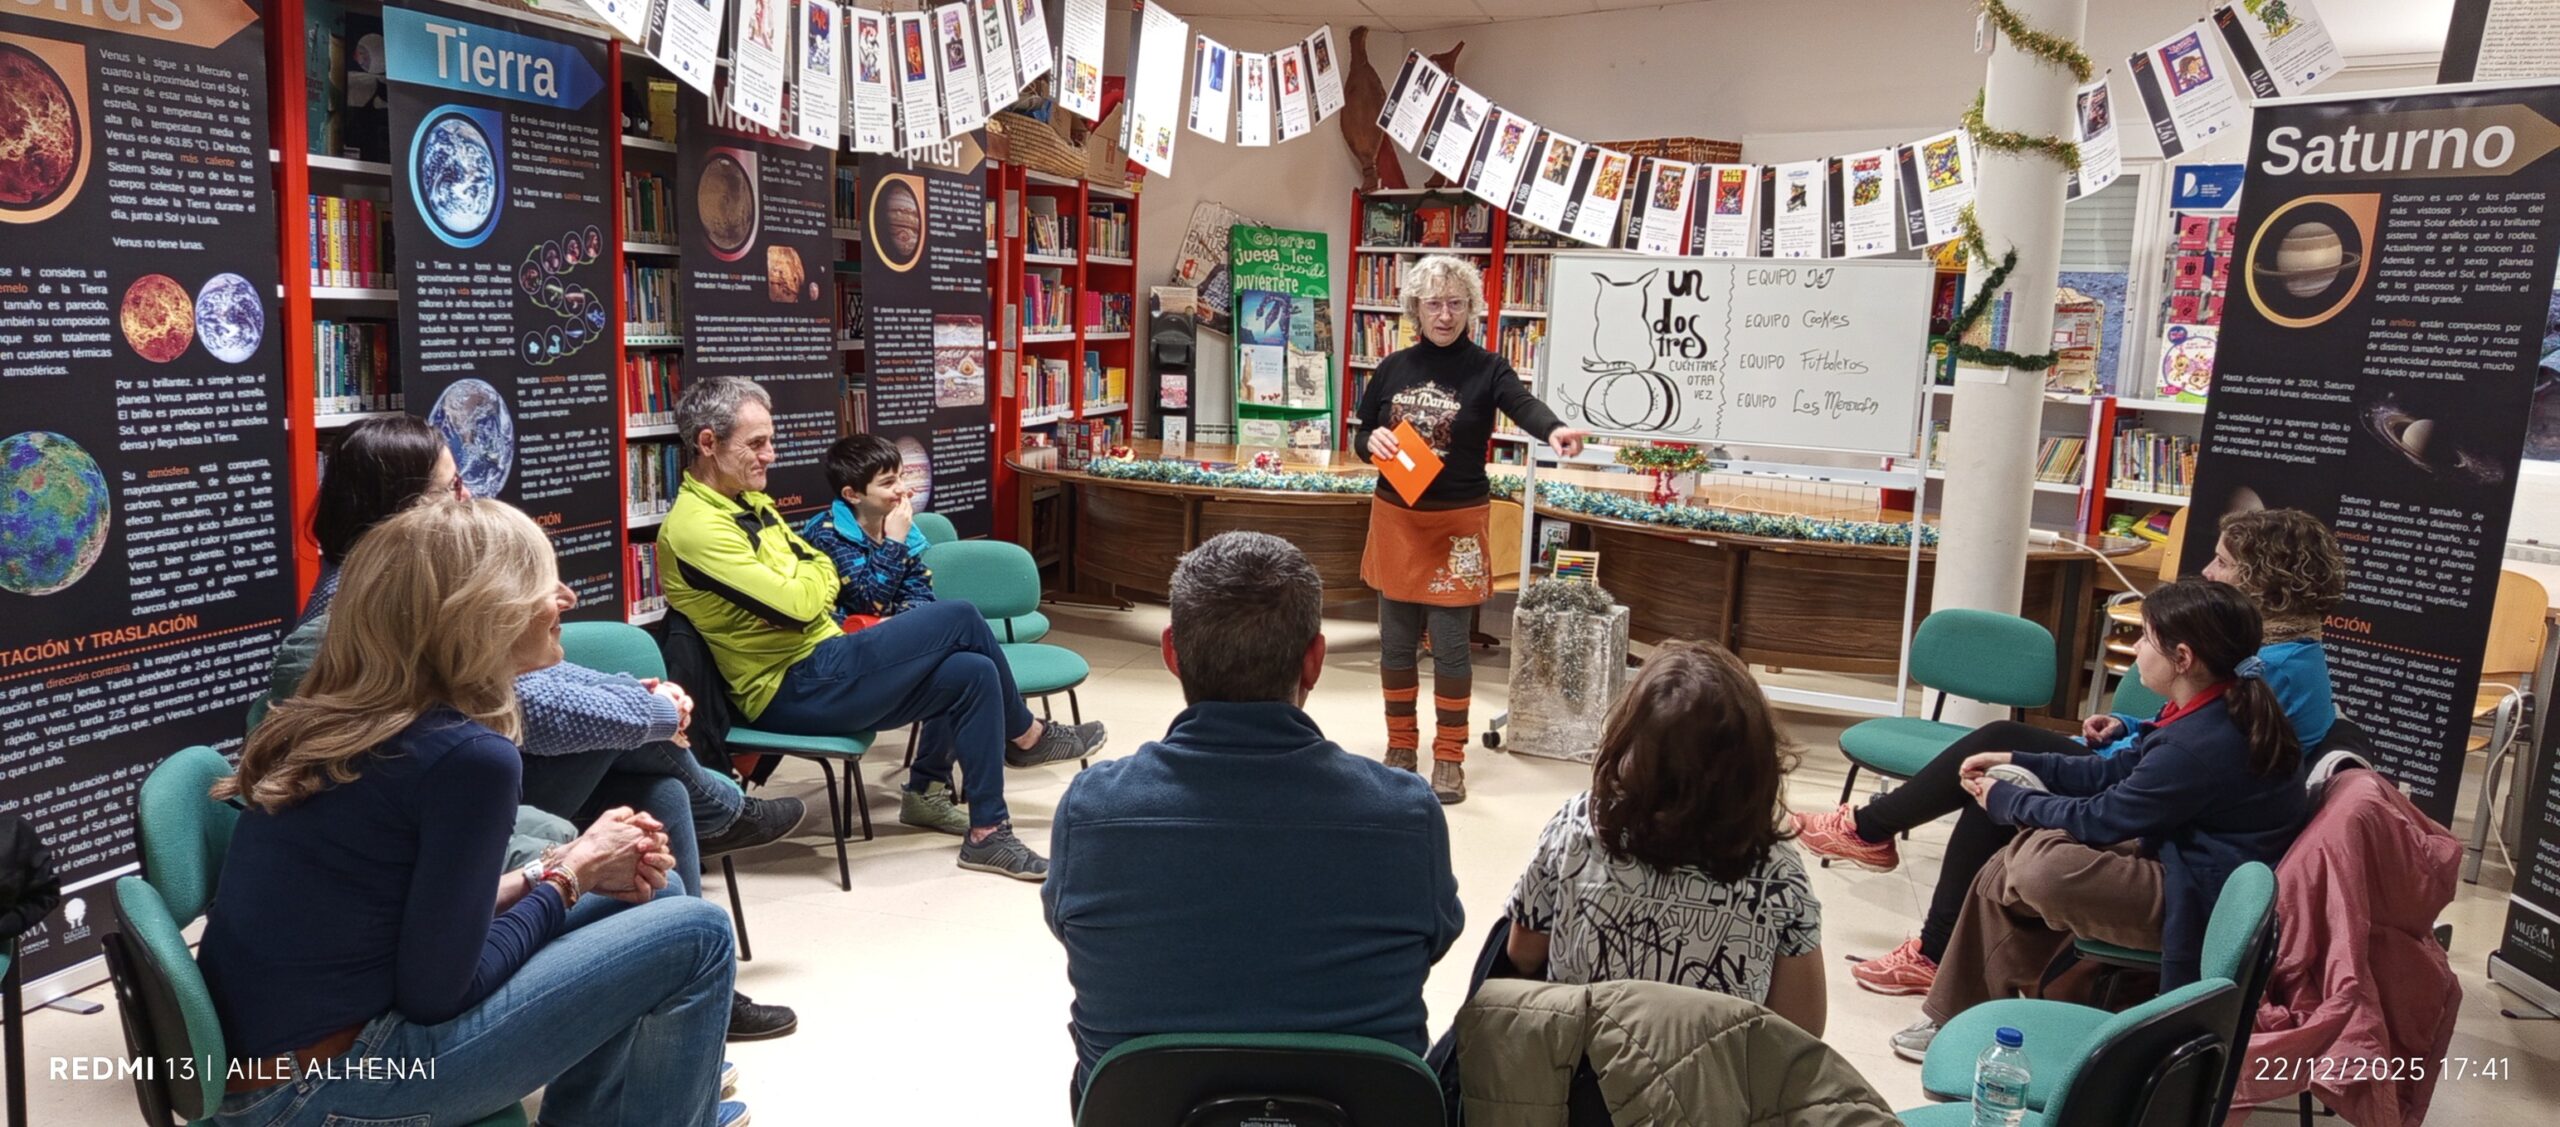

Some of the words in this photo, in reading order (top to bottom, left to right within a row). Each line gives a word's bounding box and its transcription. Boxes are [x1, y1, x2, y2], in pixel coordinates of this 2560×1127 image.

[100, 48, 130, 62] Venus
[137, 53, 146, 65] le
[152, 58, 177, 70] sigue
[183, 63, 190, 72] a
[196, 63, 232, 78] Mercurio
[236, 72, 248, 81] en
[425, 23, 558, 99] Tierra
[2250, 68, 2275, 98] 1970
[2155, 117, 2178, 145] 1971
[2261, 125, 2516, 176] Saturno
[107, 160, 146, 174] Sistema
[149, 164, 172, 176] Solar
[176, 169, 183, 179] y
[187, 170, 204, 179] uno
[207, 170, 219, 181] de
[222, 171, 235, 182] los
[238, 174, 254, 184] tres
[2391, 193, 2425, 202] Saturno
[2429, 194, 2440, 202] es
[2445, 193, 2464, 202] uno
[2467, 192, 2480, 201] de
[2485, 192, 2499, 201] los
[2504, 192, 2546, 201] planetas
[1563, 201, 1580, 224] 1979
[1909, 208, 1925, 234] 1974
[2389, 206, 2407, 215] más
[2416, 206, 2451, 215] vistosos
[2460, 206, 2467, 216] y
[2476, 205, 2517, 214] coloridos
[2527, 204, 2544, 213] del
[1628, 216, 1643, 239] 1978
[1831, 220, 1845, 245] 1975
[2387, 218, 2421, 227] Sistema
[2423, 218, 2446, 227] Solar
[2447, 218, 2478, 227] debido
[2479, 219, 2487, 227] a
[2489, 219, 2501, 227] su
[2503, 217, 2541, 227] brillante
[112, 236, 143, 248] Venus
[143, 239, 156, 248] no
[156, 239, 178, 249] tiene
[178, 239, 204, 250] lunas.
[1253, 231, 1316, 250] colorea
[1692, 226, 1706, 249] 1977
[1761, 227, 1774, 251] 1976
[2385, 232, 2418, 240] sistema
[2425, 231, 2438, 240] de
[2440, 230, 2469, 240] anillos
[2472, 232, 2491, 241] que
[2494, 230, 2504, 240] lo
[2507, 232, 2537, 240] rodea.
[1235, 248, 1280, 266] juega
[1292, 248, 1313, 264] lee
[0, 267, 12, 276] se
[20, 266, 31, 277] le
[38, 268, 87, 278] considera
[93, 269, 107, 278] un
[1272, 262, 1327, 278] aprende
[1746, 268, 1797, 287] EQUIPO
[37, 282, 52, 294] de
[60, 283, 71, 294] la
[80, 283, 108, 294] Tierra
[1666, 269, 1710, 302] un
[3, 299, 43, 310] tamaño
[47, 300, 60, 310] es
[64, 300, 108, 310] parecido,
[36, 317, 49, 326] su
[50, 316, 110, 326] composición
[1653, 298, 1706, 342] dos
[1745, 313, 1790, 329] EQUIPO
[1802, 309, 1850, 329] Cookies
[2370, 317, 2386, 326] Los
[2419, 320, 2444, 328] están
[2447, 321, 2501, 331] compuestos
[2504, 324, 2522, 333] por
[32, 333, 52, 343] son
[61, 332, 111, 342] totalmente
[1656, 334, 1708, 360] tres
[0, 351, 14, 360] en
[16, 349, 70, 360] cuestiones
[71, 348, 112, 358] térmicas
[1739, 353, 1785, 371] EQUIPO
[1800, 348, 1869, 375] Futboleros
[2, 364, 68, 377] atmosféricas.
[1687, 374, 1715, 386] OTRA
[1694, 390, 1713, 400] VEZ
[1736, 392, 1777, 409] EQUIPO
[1792, 389, 1820, 416] Los
[2340, 494, 2371, 506] Saturno
[2379, 500, 2400, 510] tiene
[2408, 504, 2421, 512] un
[2428, 506, 2462, 518] tamaño
[2471, 511, 2484, 521] de
[2338, 505, 2370, 518] 120.536
[2371, 510, 2414, 524] kilómetros
[2415, 517, 2428, 526] de
[2429, 518, 2470, 532] diámetro.
[2473, 524, 2482, 533] A
[74, 635, 85, 652] Y
[89, 614, 198, 648] TRASLACIÓN
[2322, 612, 2371, 634] ACIÓN
[8, 685, 29, 700] gira
[29, 682, 44, 693] en
[45, 672, 89, 689] dirección
[90, 663, 131, 679] contraria
